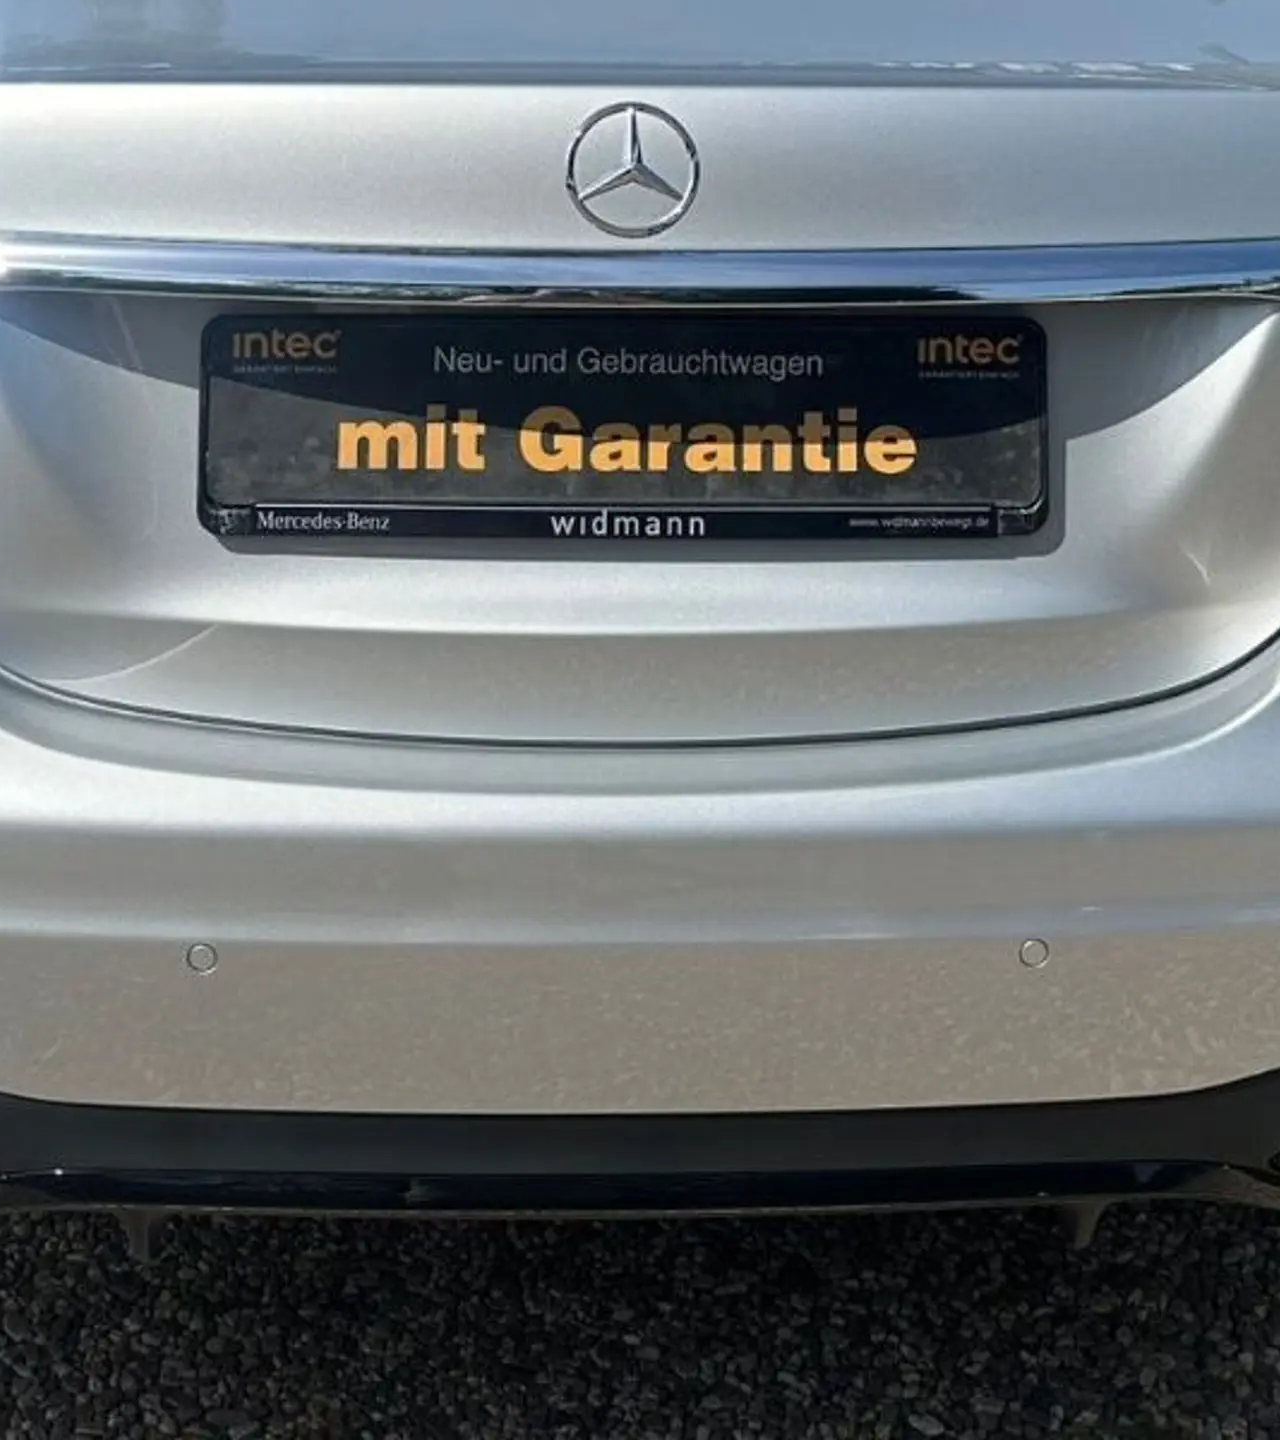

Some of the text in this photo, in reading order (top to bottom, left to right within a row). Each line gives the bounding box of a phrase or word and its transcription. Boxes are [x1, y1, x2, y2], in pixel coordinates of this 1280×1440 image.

[232, 327, 338, 359] intec
[917, 333, 1021, 365] intec
[433, 345, 824, 383] Neu- und Gebrauchtwagen
[337, 404, 918, 474] mit Garantie
[256, 509, 391, 532] Mercedes-Benz
[550, 508, 707, 537] widmann
